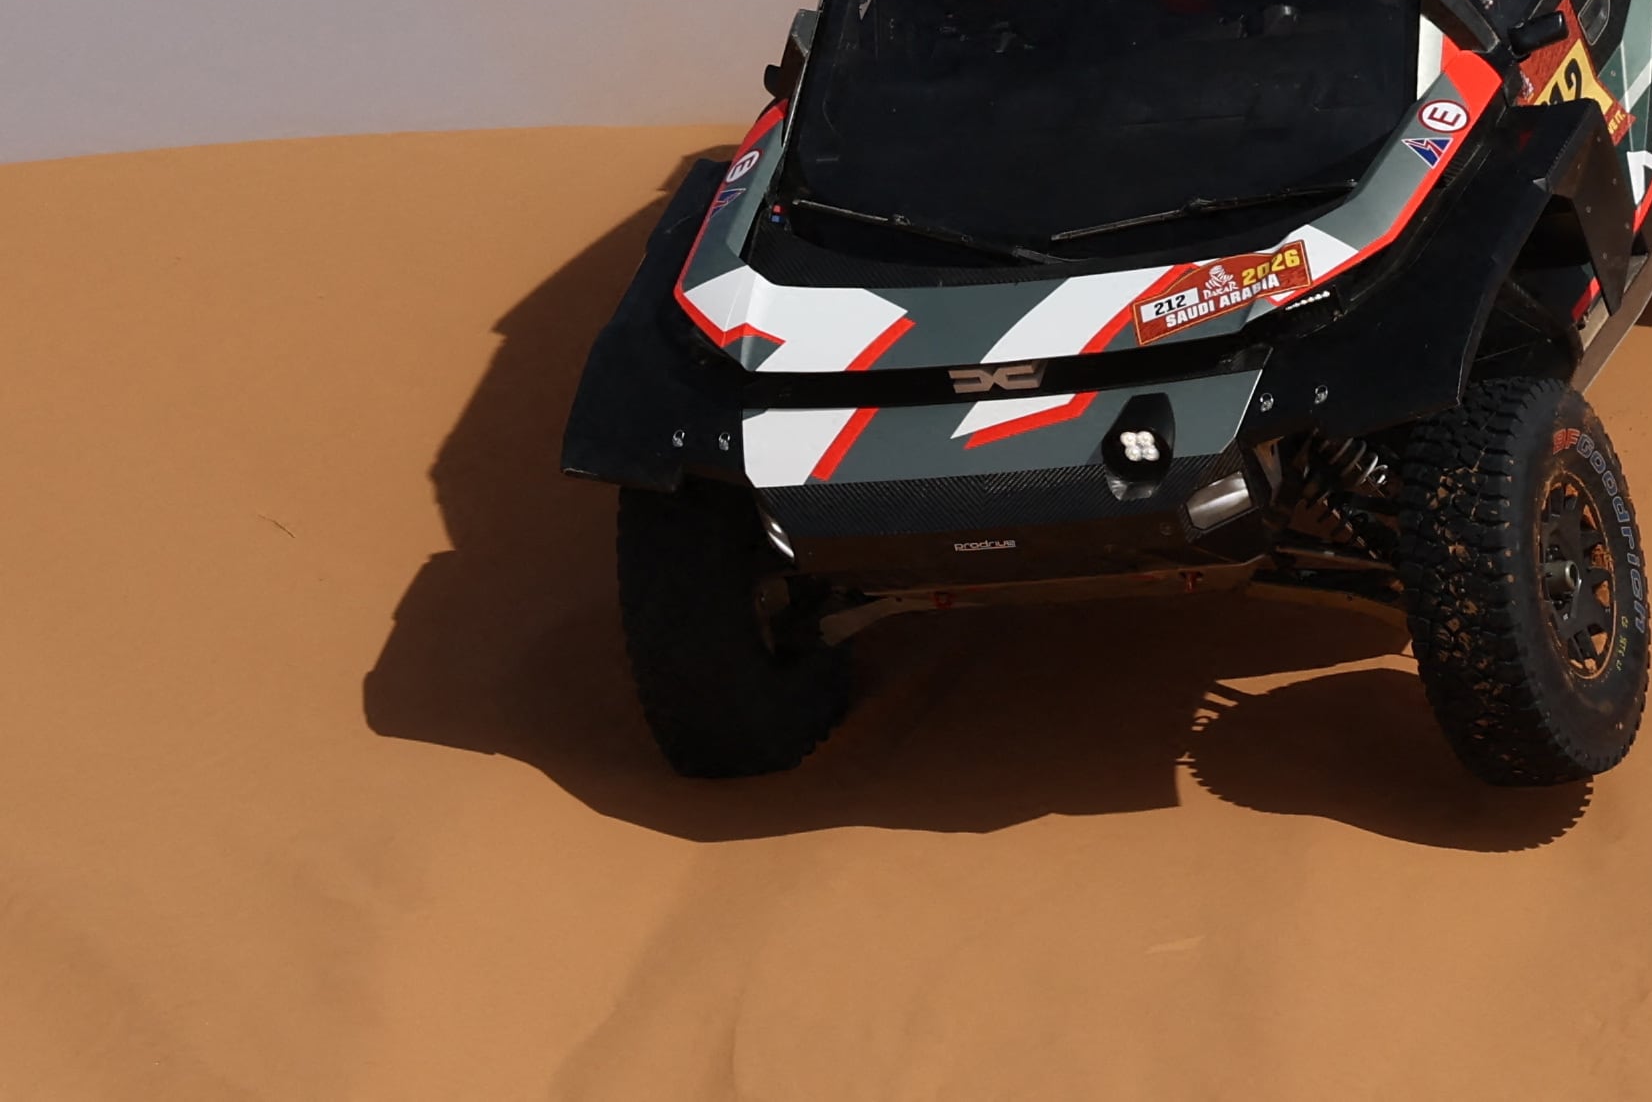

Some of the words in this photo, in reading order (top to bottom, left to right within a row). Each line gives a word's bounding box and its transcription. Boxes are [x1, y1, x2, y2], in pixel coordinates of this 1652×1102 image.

[1241, 248, 1300, 286] 2026
[1153, 294, 1187, 316] 212
[1166, 301, 1216, 328] SAUDI
[1219, 273, 1280, 308] ARABIA
[1552, 428, 1645, 634] BFGoodrich
